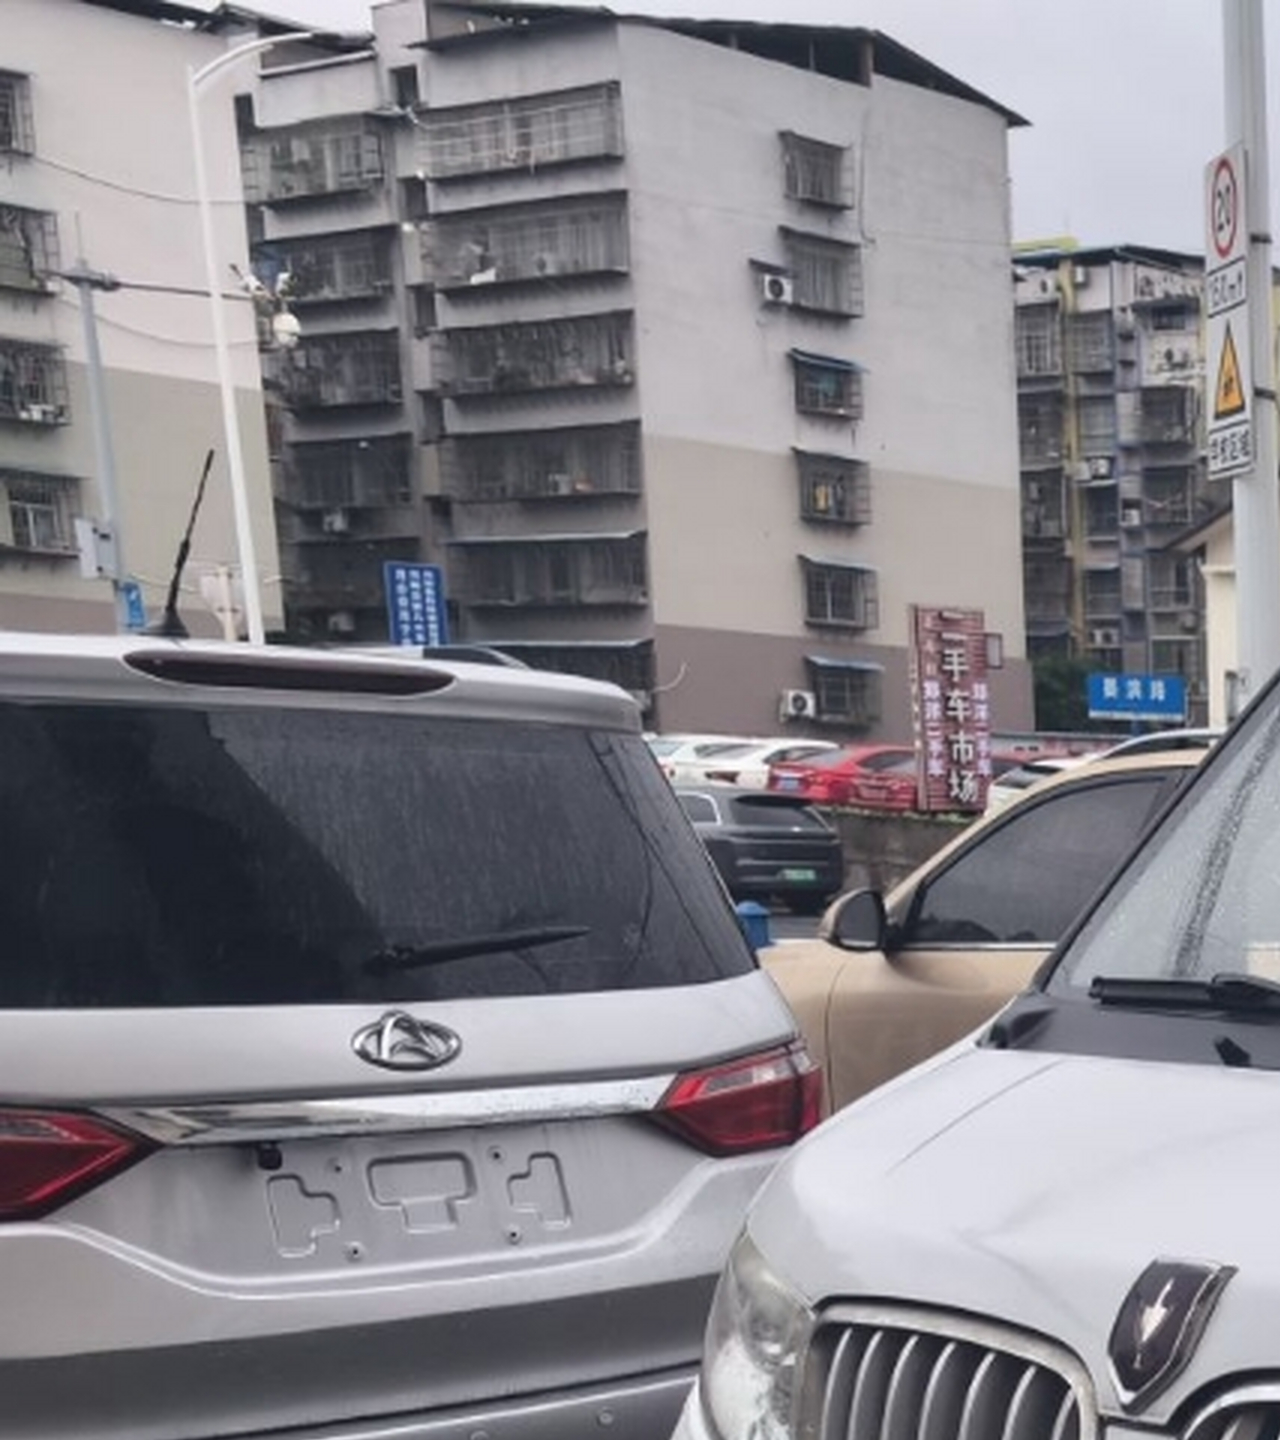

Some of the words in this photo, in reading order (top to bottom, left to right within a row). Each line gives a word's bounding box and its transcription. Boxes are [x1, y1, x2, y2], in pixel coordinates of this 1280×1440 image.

[1216, 182, 1232, 233] 20
[941, 610, 978, 803] 二手车市场
